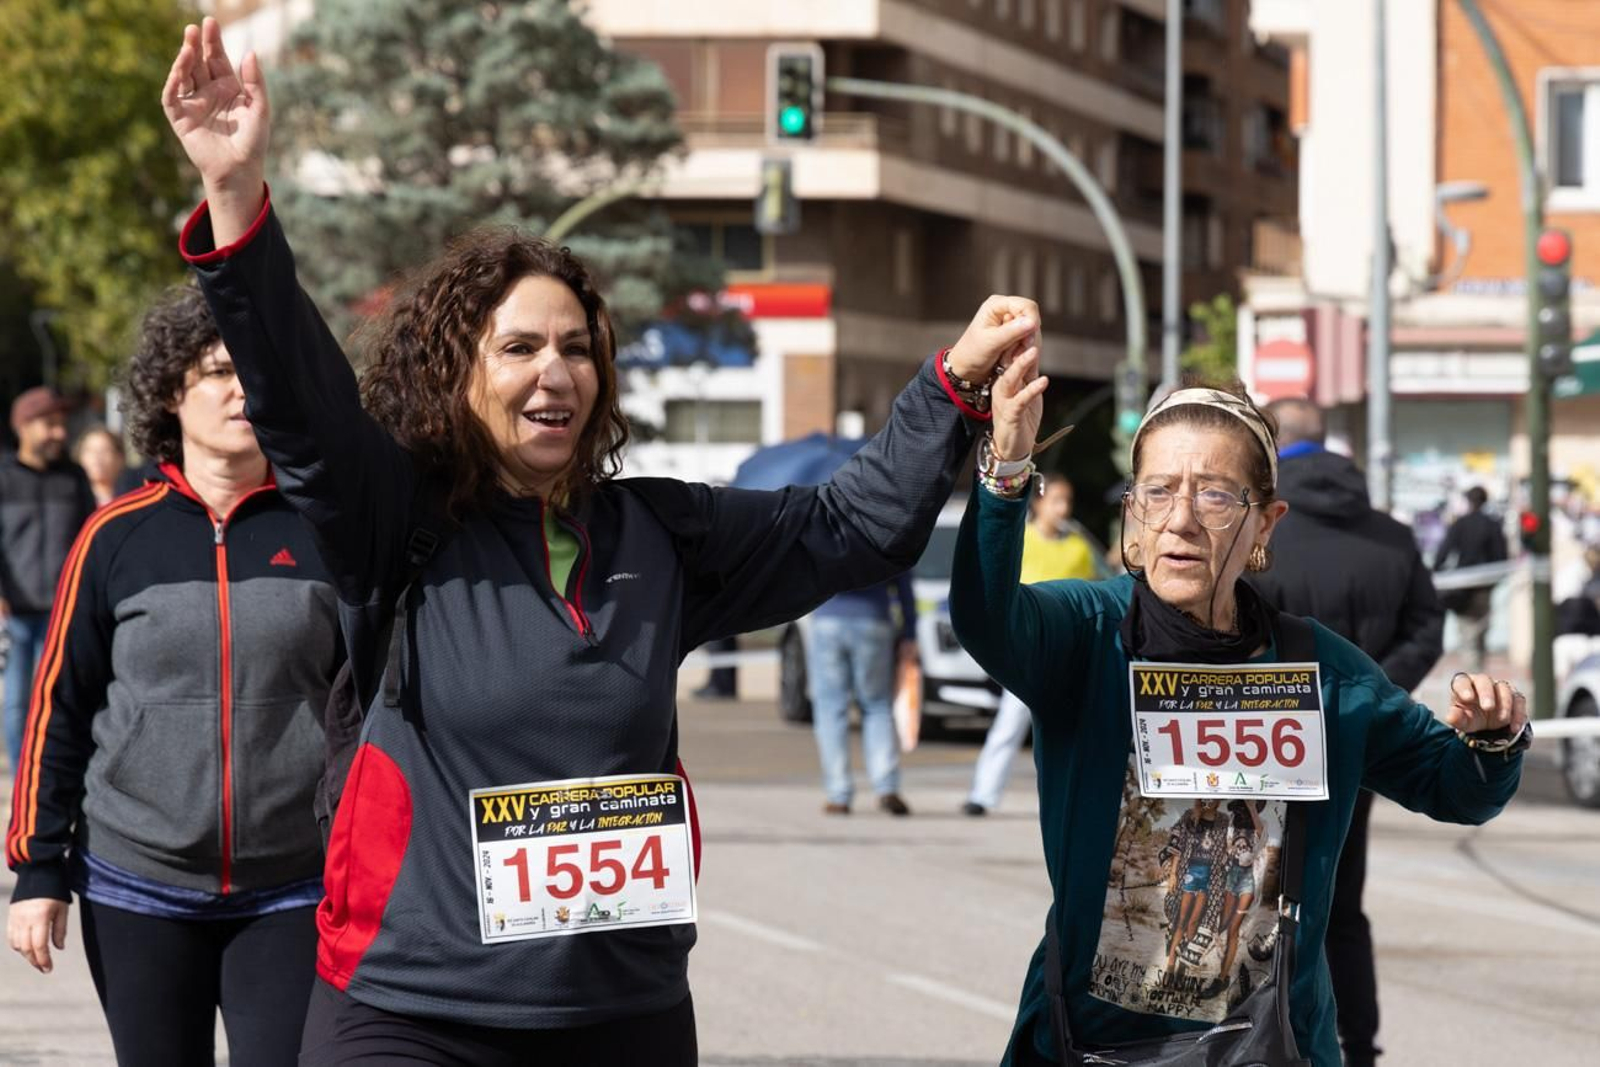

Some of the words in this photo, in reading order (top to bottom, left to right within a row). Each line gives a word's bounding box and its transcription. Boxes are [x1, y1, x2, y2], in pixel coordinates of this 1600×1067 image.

[1140, 672, 1178, 696] XXV
[1181, 673, 1243, 685] CARRERA
[1246, 673, 1310, 684] POPULAR
[1181, 686, 1190, 697] y
[1198, 685, 1233, 698] gran
[1242, 684, 1311, 695] caminata
[1159, 699, 1178, 709] POR
[1180, 700, 1194, 709] LA
[1224, 700, 1238, 709] LA
[1157, 718, 1306, 768] 1556
[482, 795, 526, 824] XXV
[529, 789, 600, 806] CARRERA
[602, 782, 675, 799] POPULAR
[529, 806, 540, 820] y
[550, 802, 591, 819] gran
[600, 793, 676, 811] caminata
[504, 824, 527, 837] POR
[528, 823, 545, 835] LA
[545, 820, 567, 833] PAZ
[579, 818, 595, 830] LA
[503, 835, 670, 903] 1554
